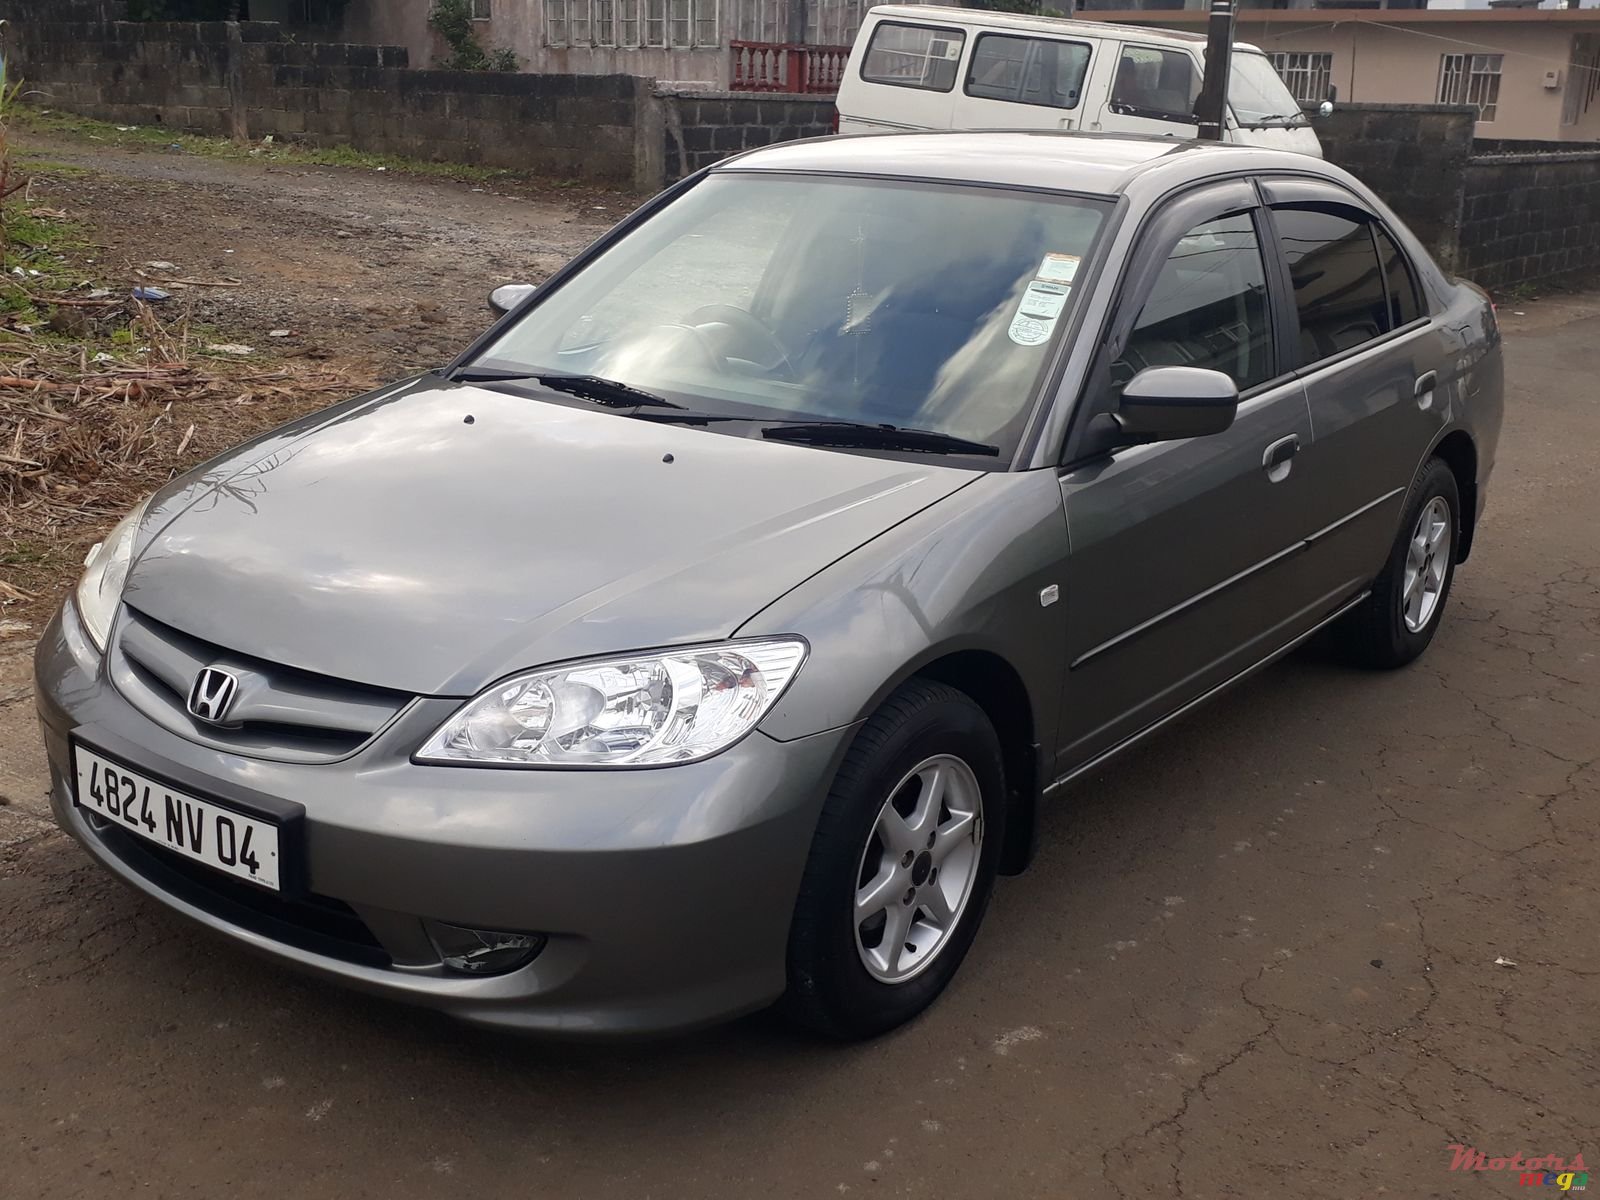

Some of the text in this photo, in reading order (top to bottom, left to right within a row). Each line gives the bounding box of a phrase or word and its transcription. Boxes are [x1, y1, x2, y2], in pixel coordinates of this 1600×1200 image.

[90, 761, 260, 874] 4824 NV 04
